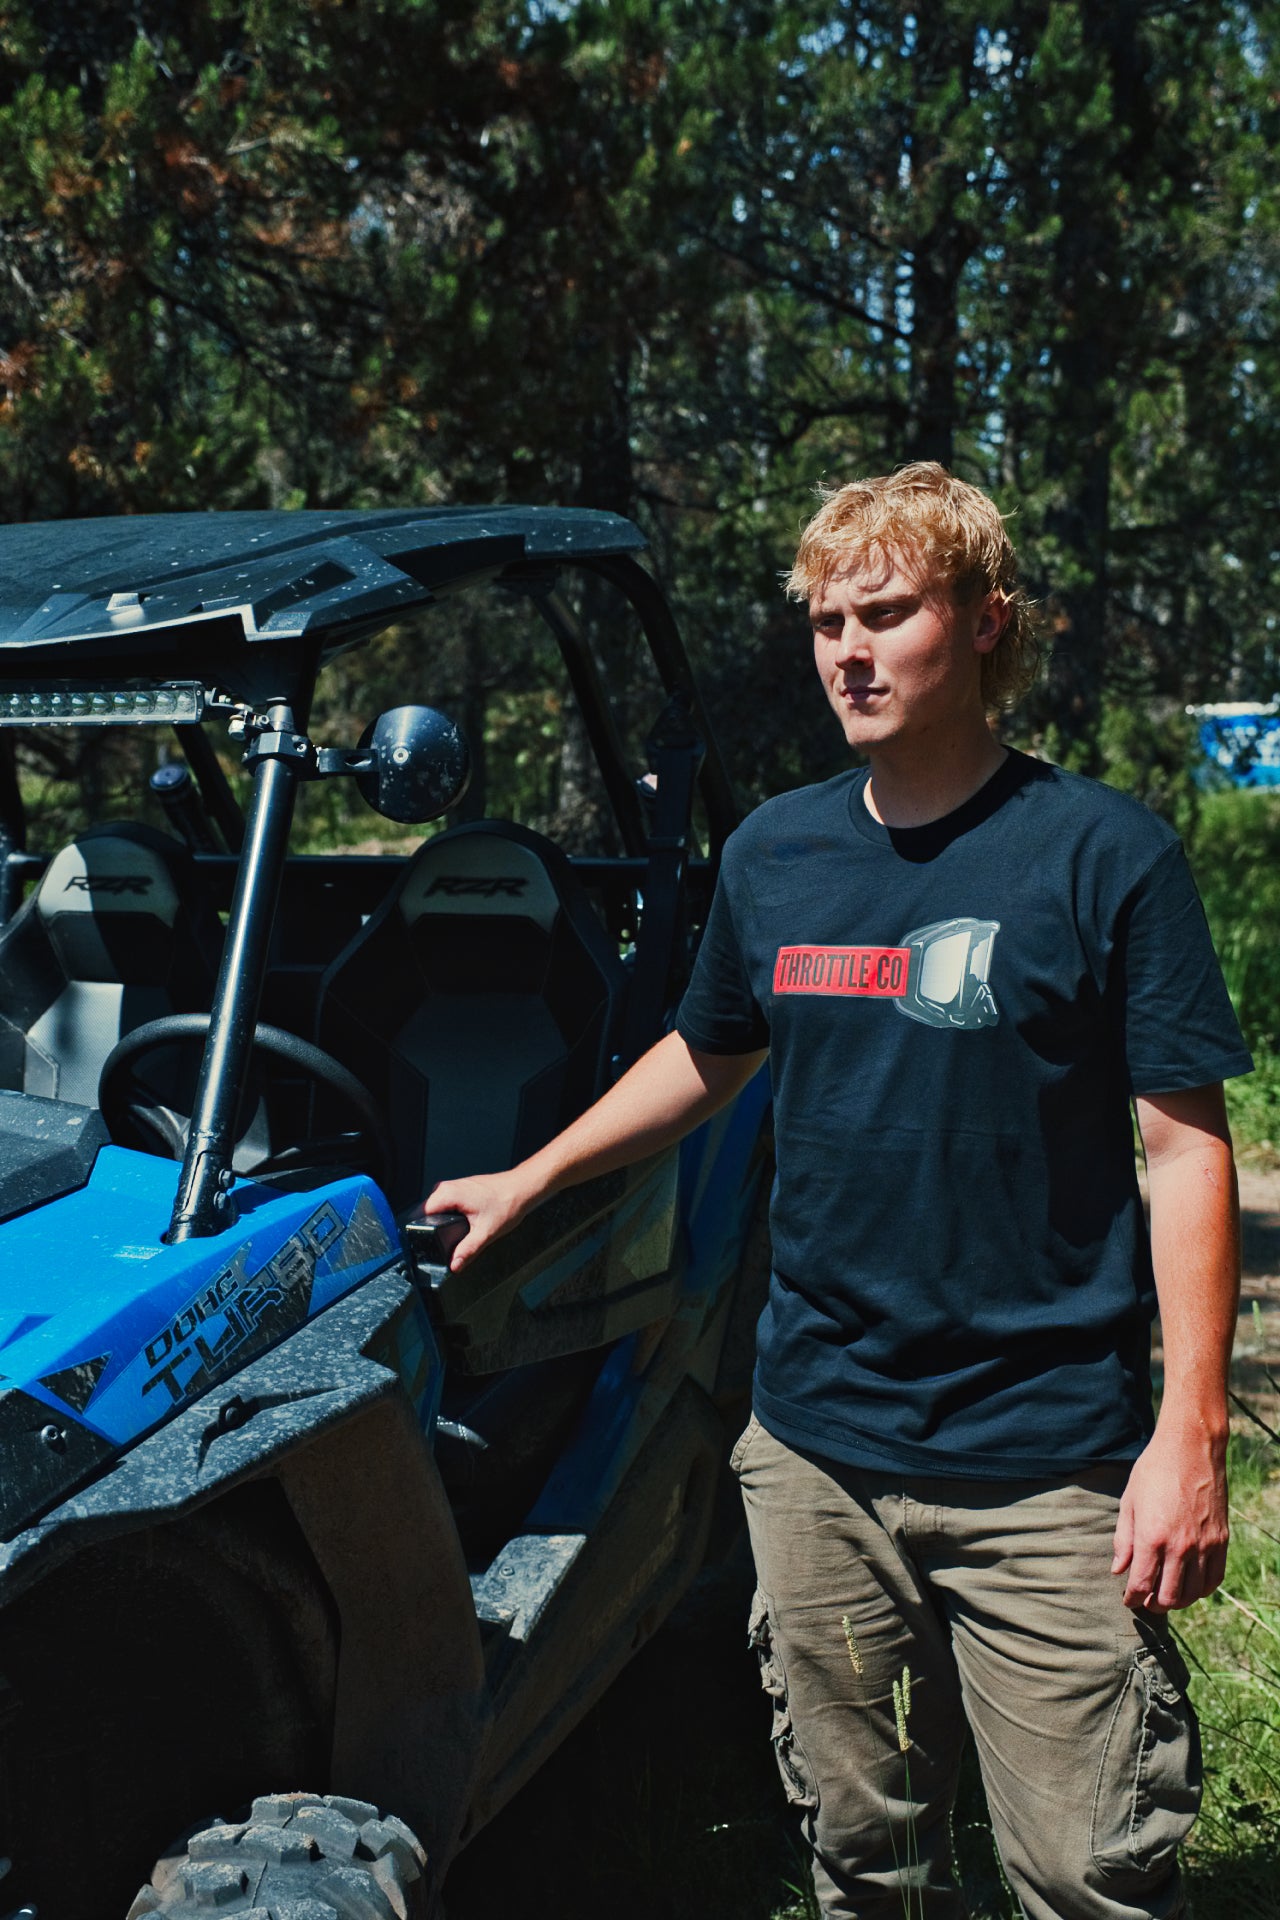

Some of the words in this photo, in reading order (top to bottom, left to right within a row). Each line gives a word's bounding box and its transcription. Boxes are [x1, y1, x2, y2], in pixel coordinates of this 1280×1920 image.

[64, 876, 154, 896] RZR
[423, 876, 529, 898] RZR
[779, 953, 871, 988] THROTTLE
[877, 954, 903, 990] CO
[141, 1199, 348, 1407] TURBO
[144, 1268, 239, 1368] DOHC
